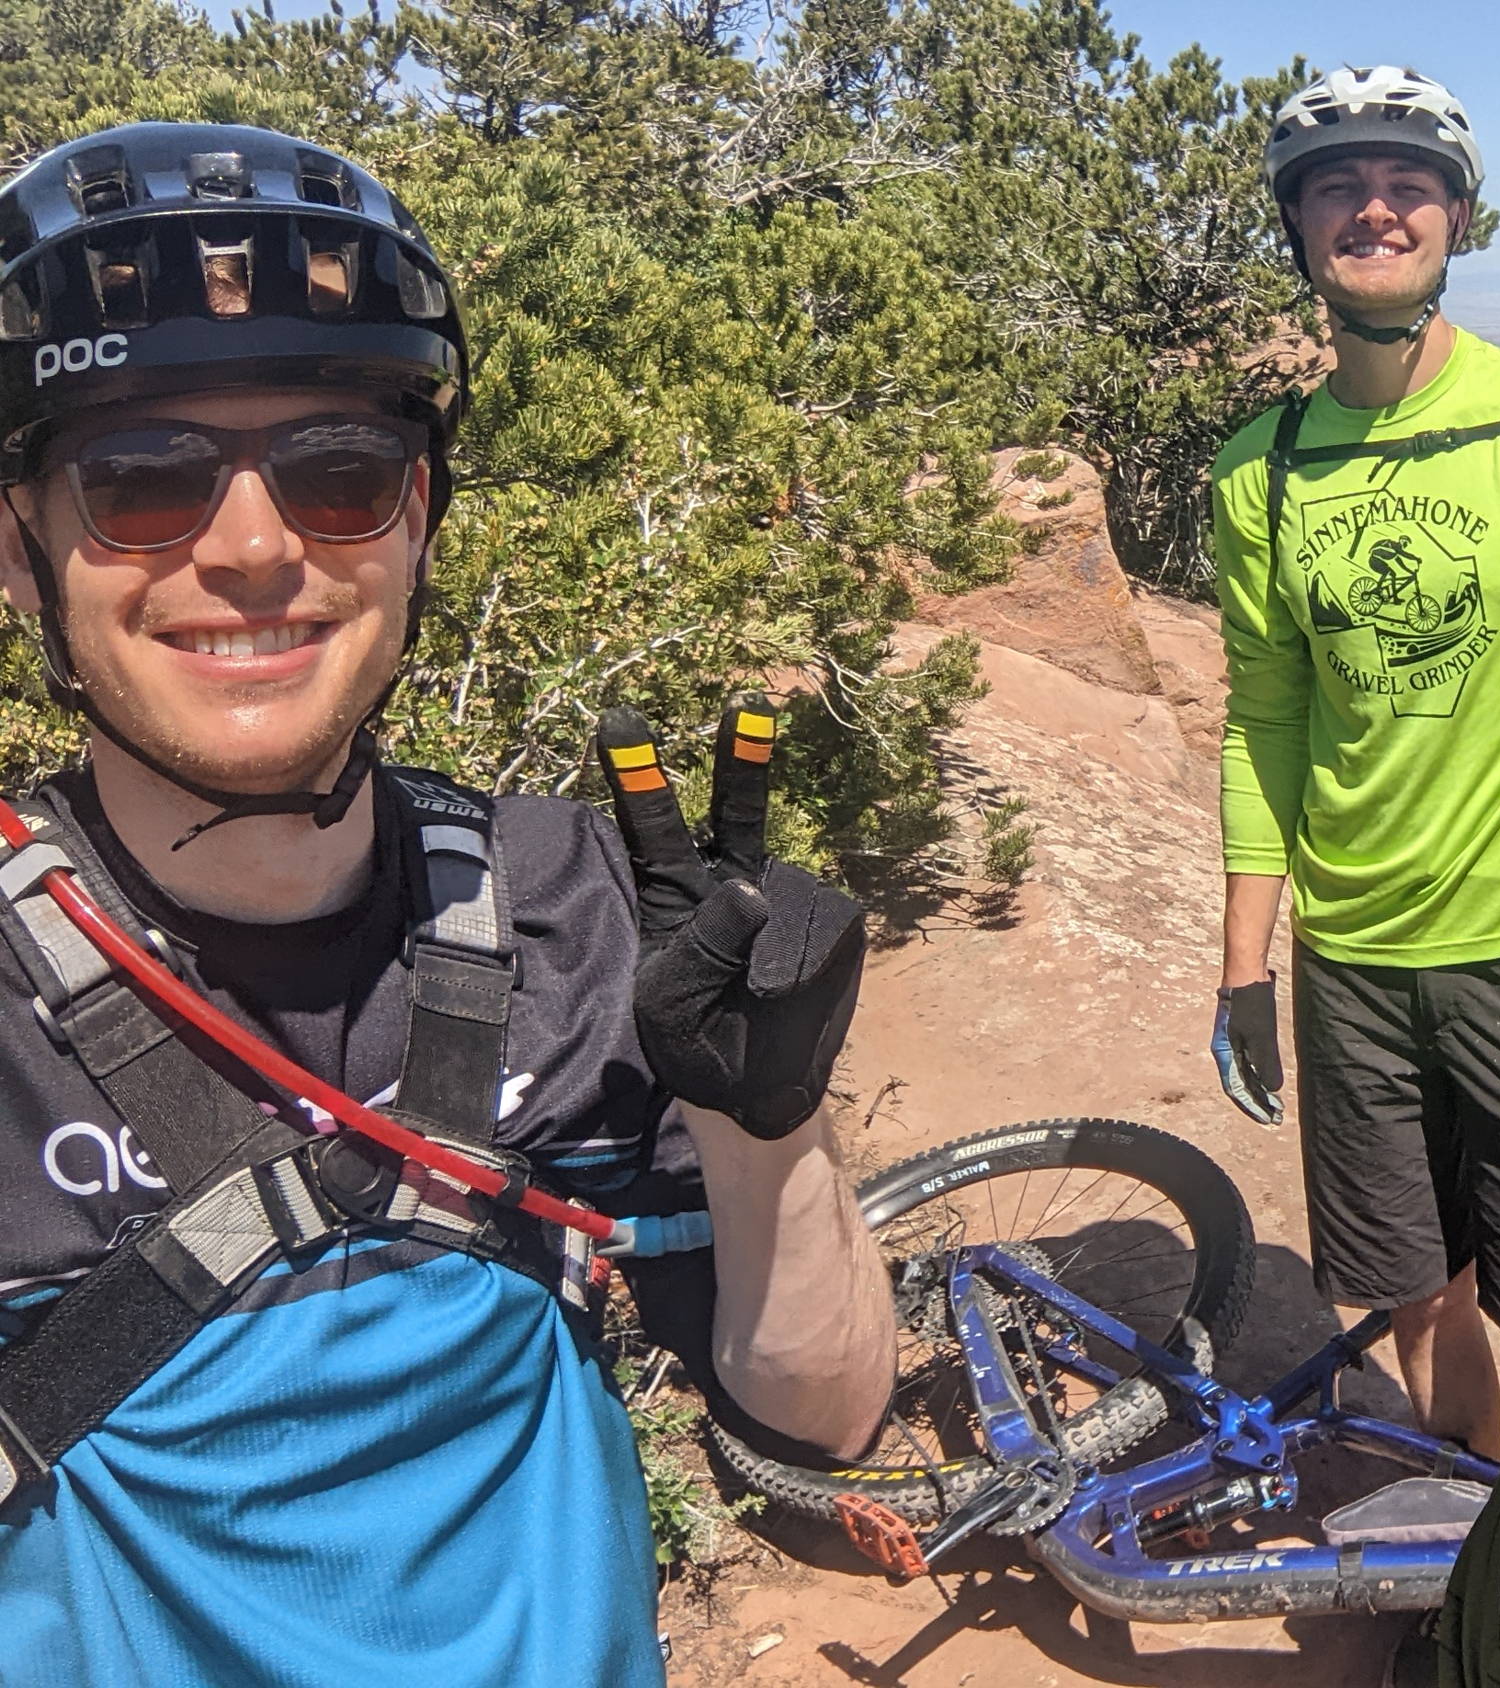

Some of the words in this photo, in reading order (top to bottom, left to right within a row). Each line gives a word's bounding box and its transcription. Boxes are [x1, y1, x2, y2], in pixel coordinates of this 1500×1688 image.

[1296, 495, 1490, 572] SINNEMAHONE
[1327, 650, 1405, 695] GRAVEL
[1409, 624, 1499, 691] GRINDER
[1166, 1552, 1287, 1576] TREK
